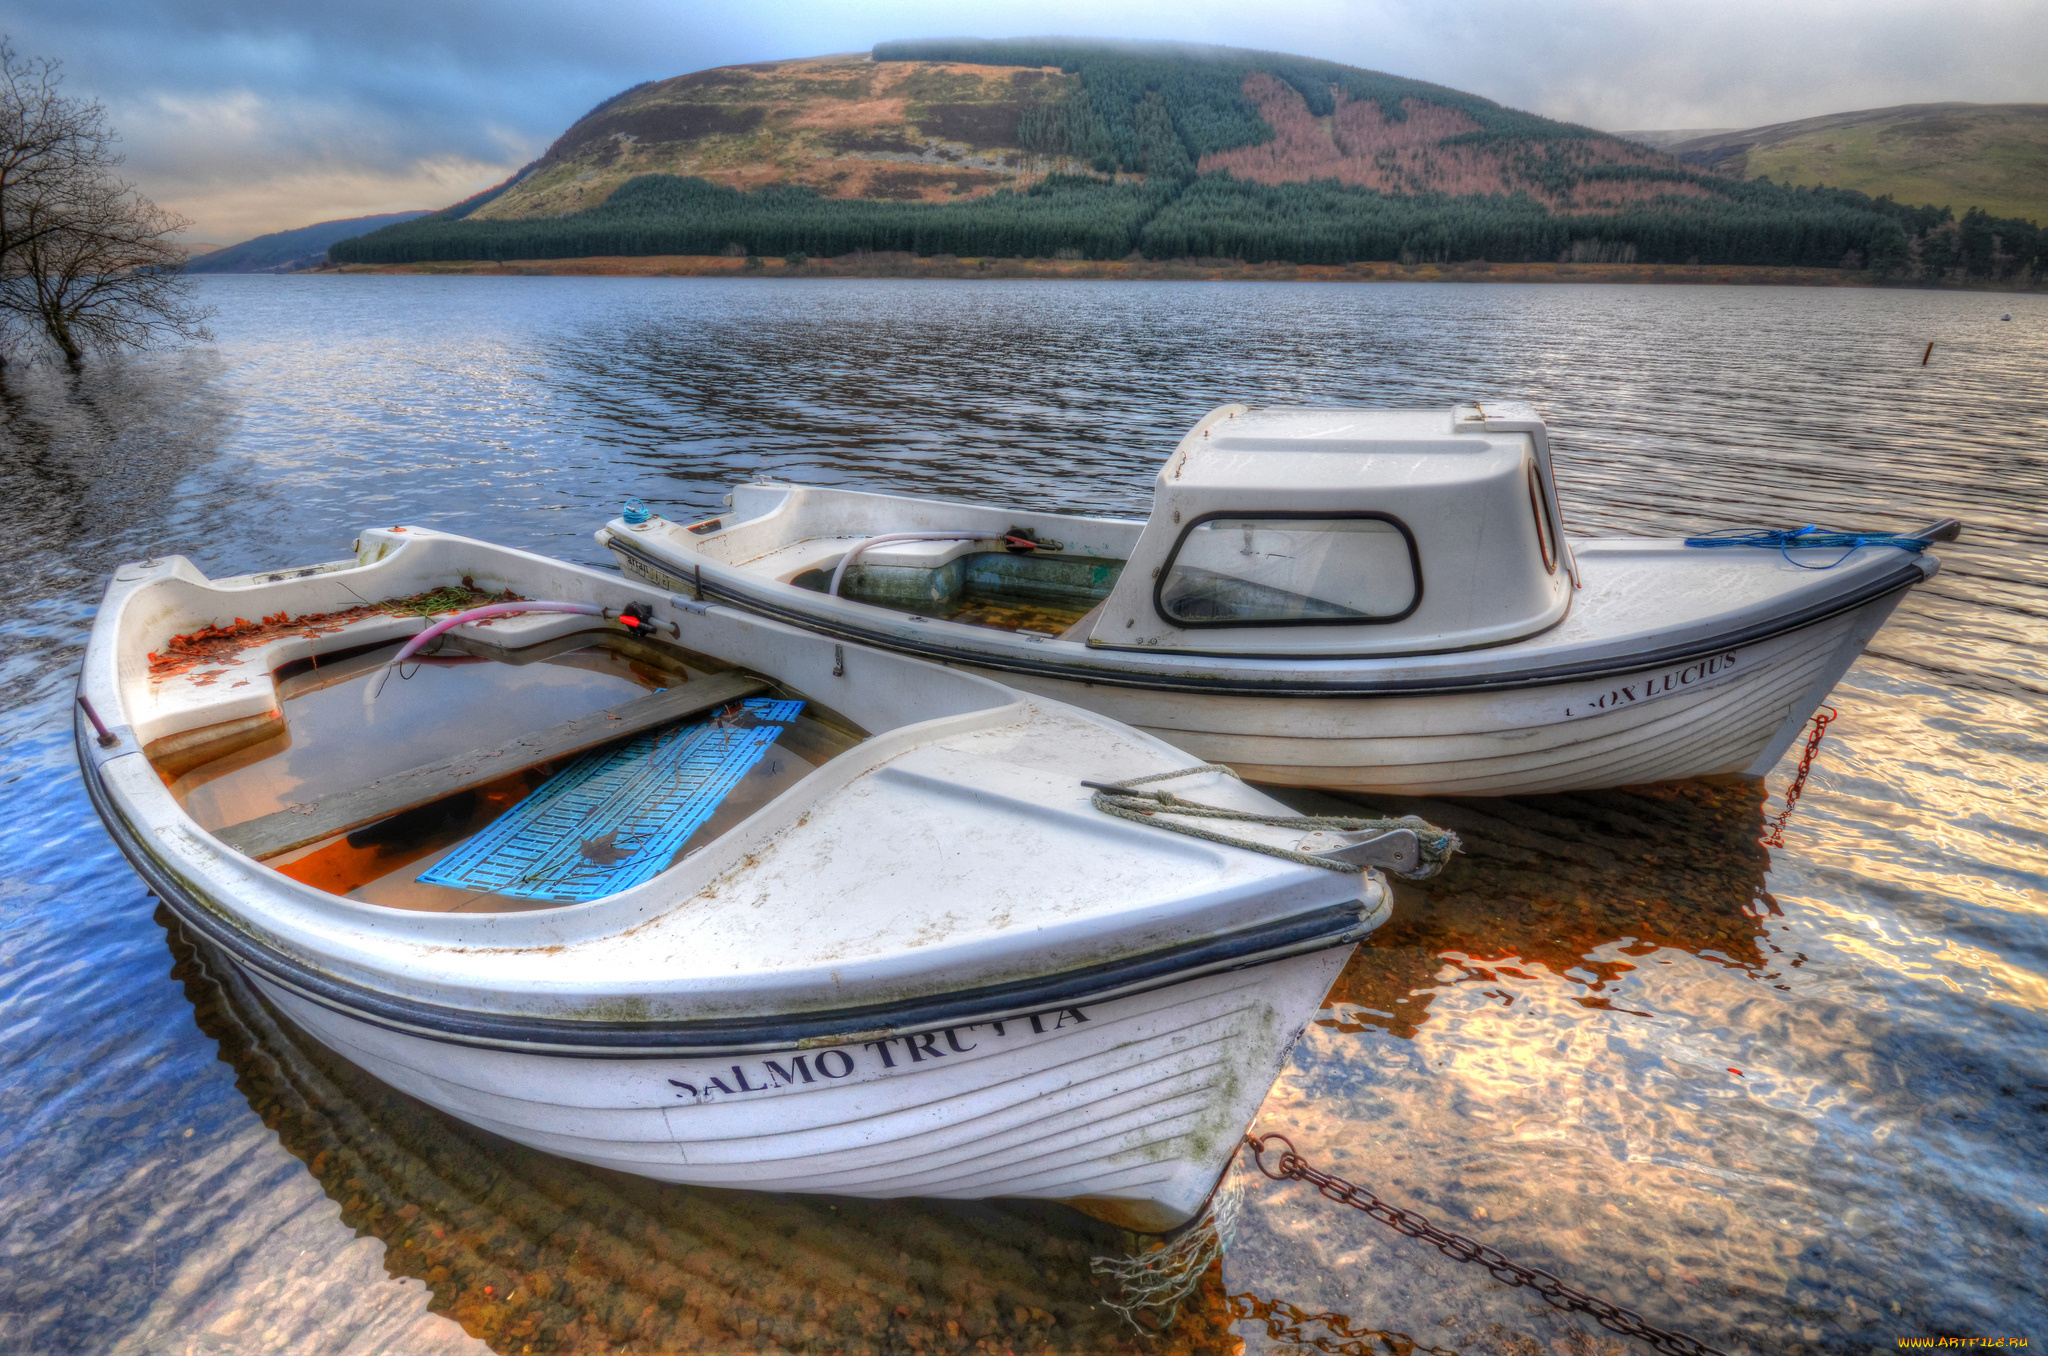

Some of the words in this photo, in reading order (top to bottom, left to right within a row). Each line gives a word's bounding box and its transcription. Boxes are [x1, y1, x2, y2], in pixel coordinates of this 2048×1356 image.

[1566, 684, 1637, 716] OX
[1645, 650, 1737, 697] LUCIUS
[667, 1049, 855, 1098] SALMO
[863, 1007, 1092, 1070] TRUA
